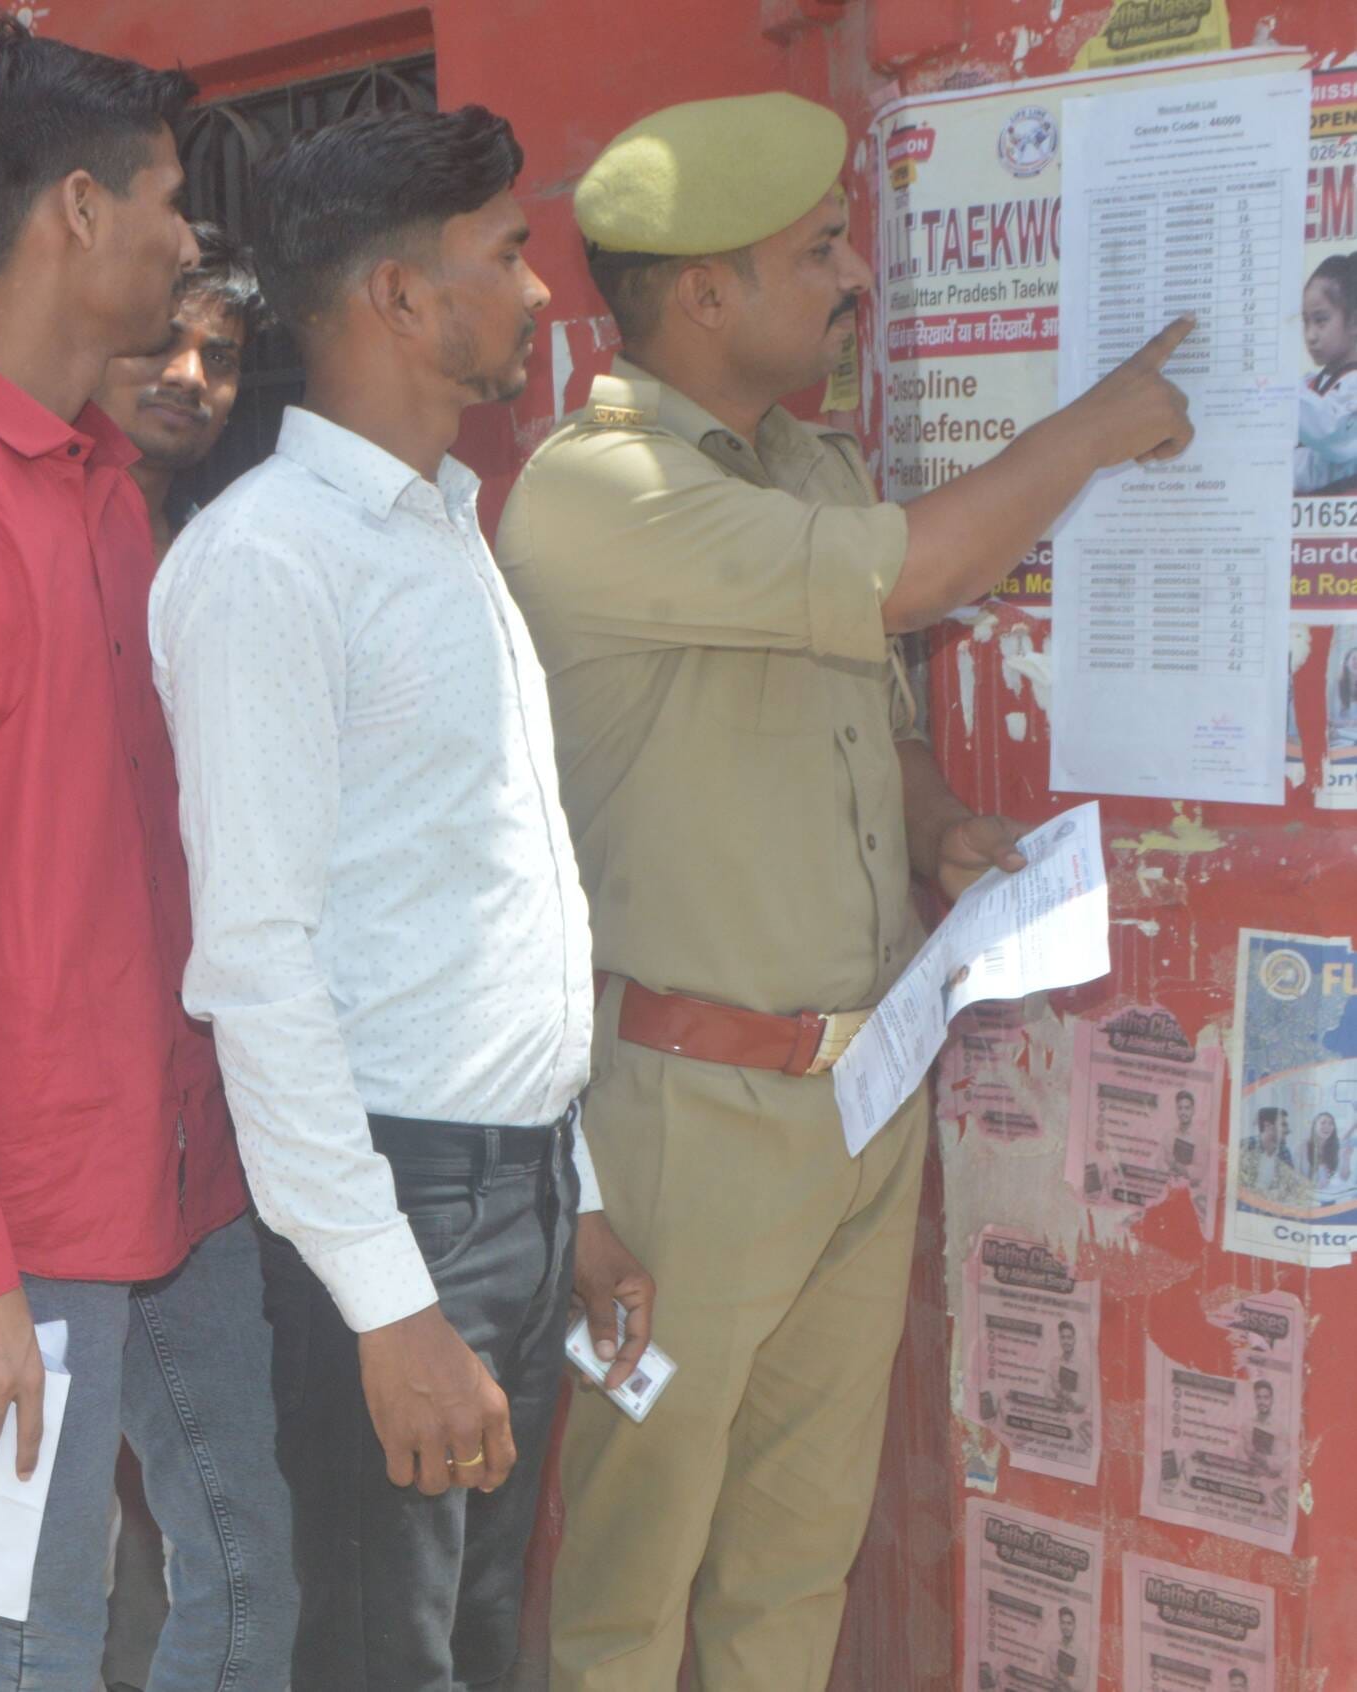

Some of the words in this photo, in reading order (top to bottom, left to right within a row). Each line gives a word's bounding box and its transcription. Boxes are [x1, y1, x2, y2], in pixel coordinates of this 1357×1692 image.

[1134, 124, 1170, 136] Centre
[1172, 119, 1200, 132] Code
[947, 280, 1007, 304] Pradesh
[1012, 275, 1059, 300] Taekw
[958, 323, 972, 342] या
[975, 322, 986, 341] न
[915, 411, 1015, 443] Defence
[1122, 482, 1156, 493] Centre
[1158, 480, 1185, 491] Code
[983, 1240, 1028, 1269] Maths
[1241, 1308, 1289, 1338] asses
[985, 1518, 1031, 1550] Maths
[1032, 1532, 1090, 1569] Classes
[1146, 1579, 1196, 1608] Maths
[1197, 1590, 1260, 1628] Classes
